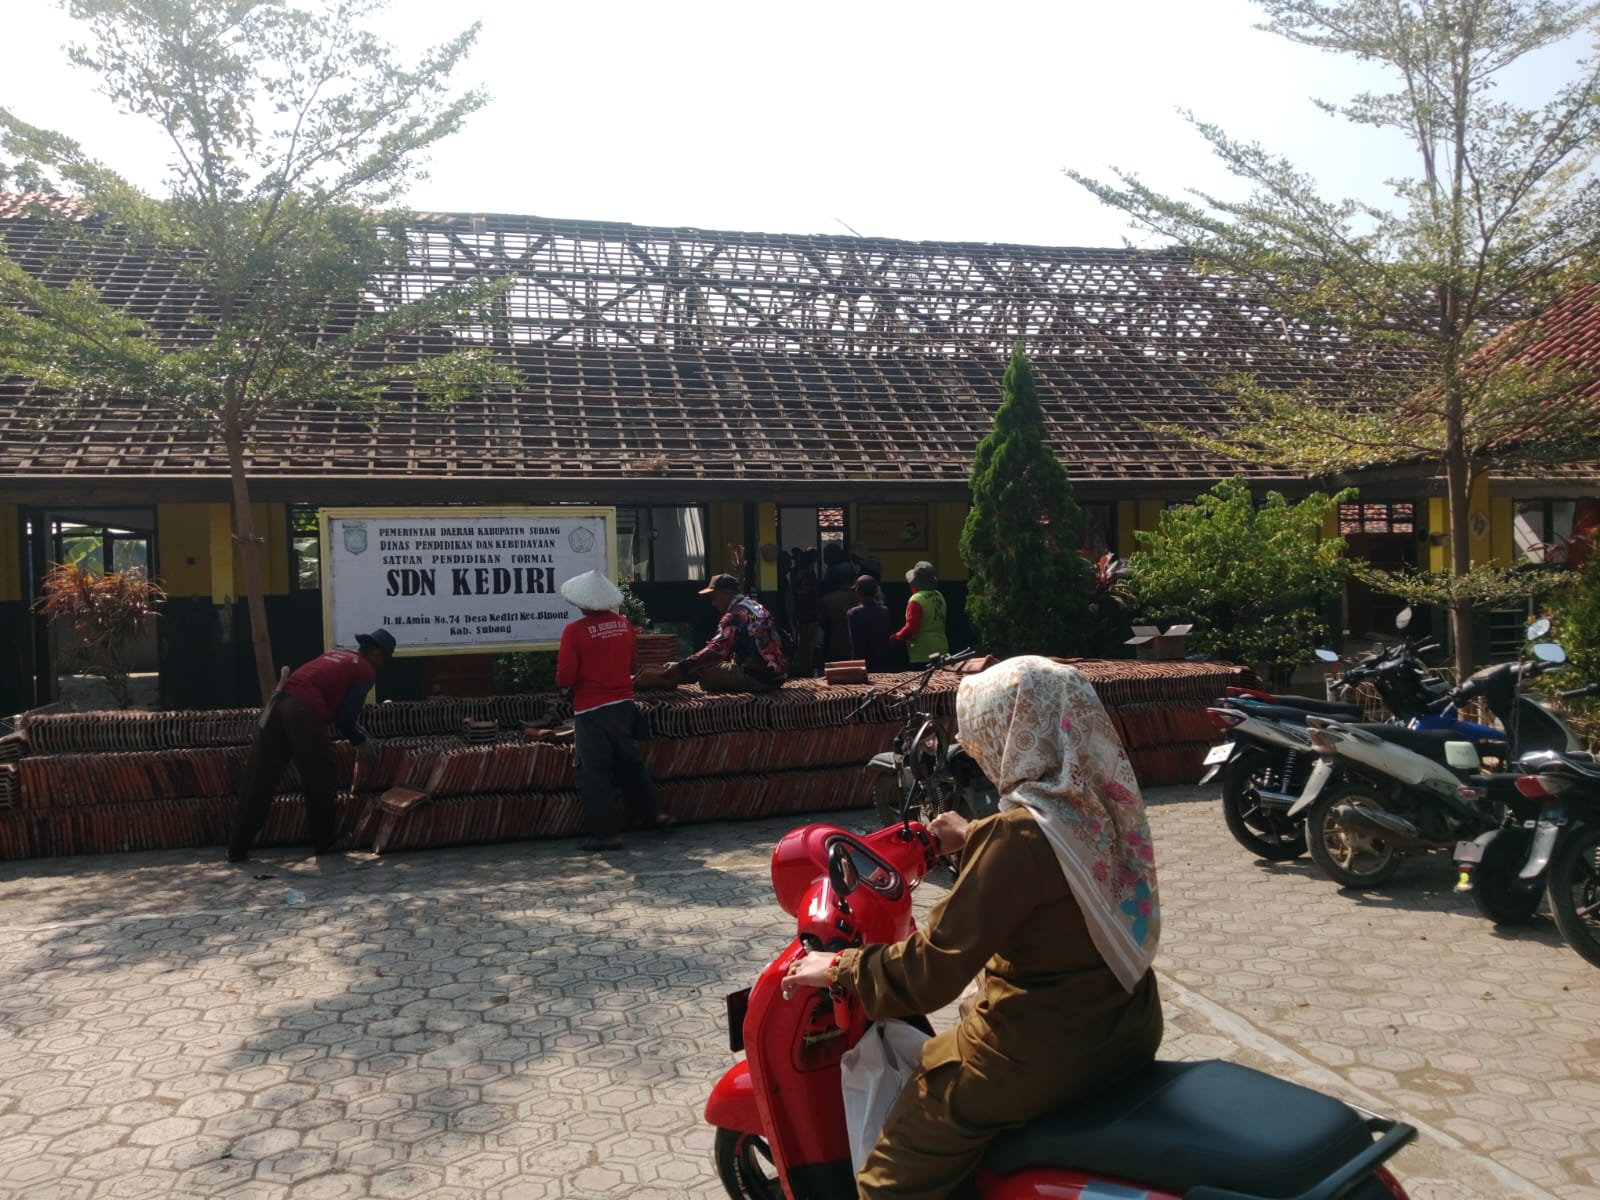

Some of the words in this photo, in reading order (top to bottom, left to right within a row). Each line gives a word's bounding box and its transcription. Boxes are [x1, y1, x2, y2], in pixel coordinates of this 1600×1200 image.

[379, 528, 436, 537] PEMERINTAH
[440, 527, 474, 536] DAERAH
[478, 527, 525, 536] KABUPATEN
[529, 526, 561, 535] SUBANG
[380, 540, 410, 551] DINAS
[415, 540, 473, 550] PENDIDIKAN
[476, 540, 493, 549] DAN
[495, 539, 555, 549] KEBUDAYAAN
[383, 555, 423, 565] SATUAN
[432, 554, 501, 564] PENDIDIKAN
[511, 554, 554, 563] FORMAL
[386, 568, 436, 597] SDN
[452, 567, 556, 596] KEDIRI
[434, 615, 460, 624] No.74
[465, 614, 486, 623] Desa
[489, 613, 518, 622] Kediri
[450, 626, 472, 636] Kab.
[476, 624, 512, 634] Subang
